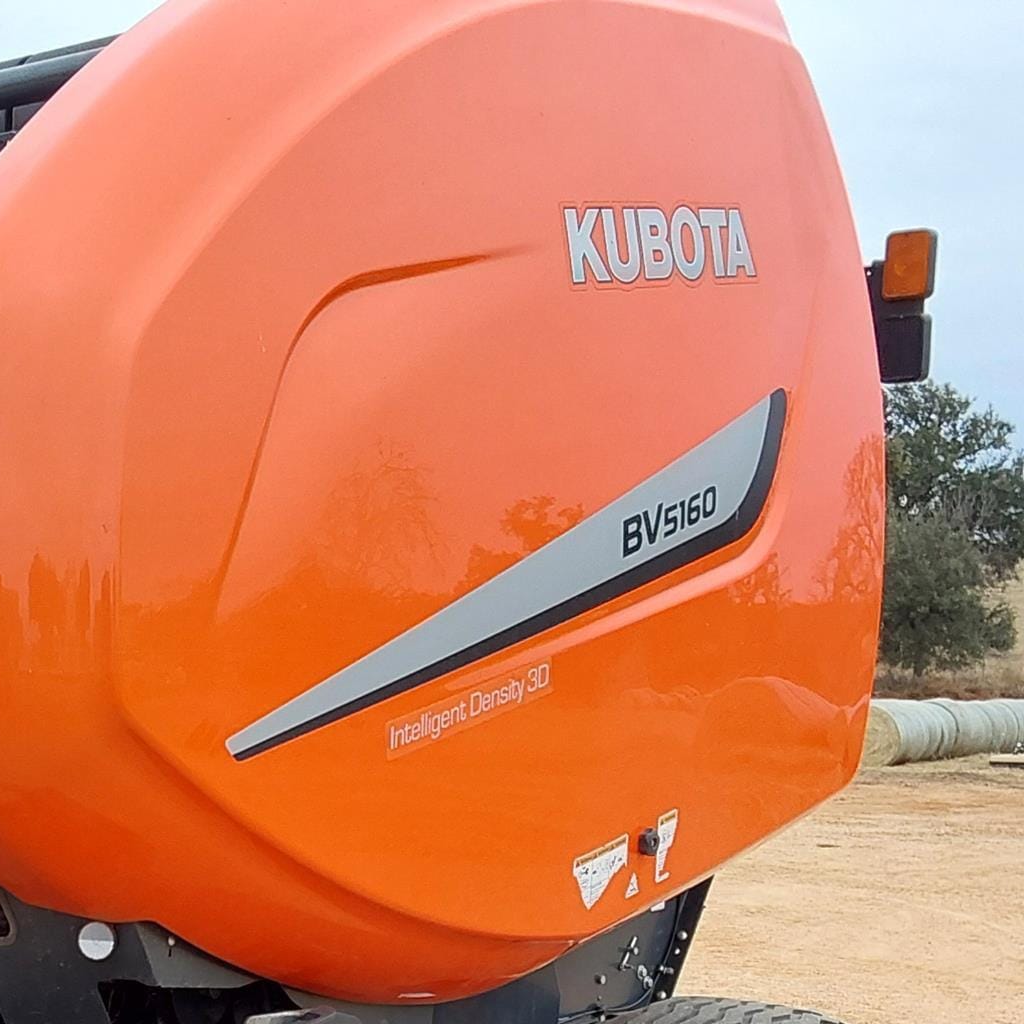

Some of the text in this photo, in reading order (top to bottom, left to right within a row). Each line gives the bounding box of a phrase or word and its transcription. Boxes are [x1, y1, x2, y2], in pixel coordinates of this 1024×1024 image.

[563, 206, 757, 283] KUBOTA
[622, 485, 717, 558] BV5160
[390, 663, 551, 749] Intelligent Density 3D
